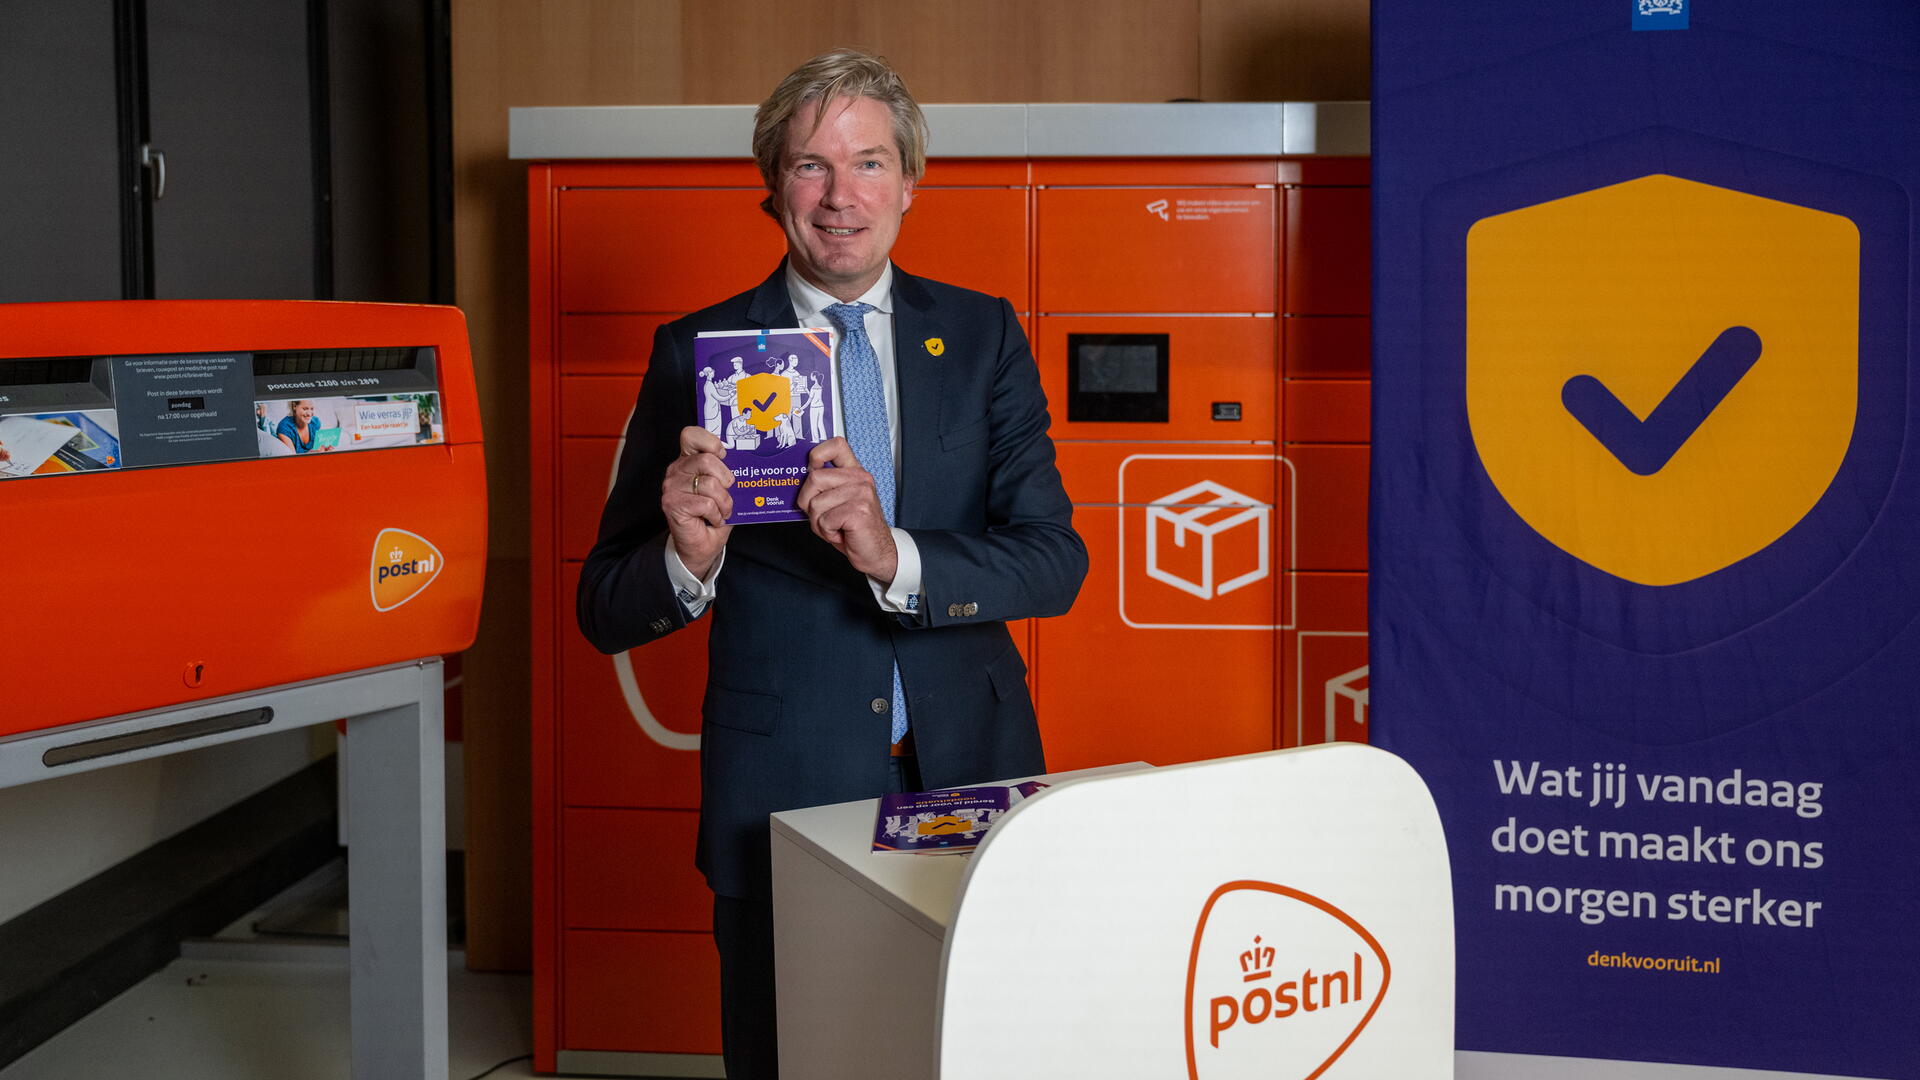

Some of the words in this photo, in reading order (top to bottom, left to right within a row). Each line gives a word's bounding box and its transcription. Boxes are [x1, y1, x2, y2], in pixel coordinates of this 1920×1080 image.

[267, 381, 315, 391] postcodes
[190, 411, 218, 419] opgehaald
[359, 411, 376, 420] Wie
[377, 410, 402, 419] verras
[731, 467, 749, 477] reid
[751, 467, 760, 478] je
[761, 467, 784, 475] voor
[785, 467, 799, 476] op
[737, 477, 800, 488] noodsituatie
[378, 553, 435, 584] postnl
[1493, 760, 1582, 797] Wat
[1589, 762, 1627, 808] jij
[1636, 769, 1824, 818] vandaag
[1491, 817, 1589, 857] doet
[1599, 826, 1736, 864] maakt
[1745, 837, 1824, 869] ons
[1495, 883, 1657, 924] morgen
[1667, 889, 1822, 928] sterker
[1587, 951, 1720, 973] denkvooruit.nl
[1210, 951, 1362, 1049] postnl
